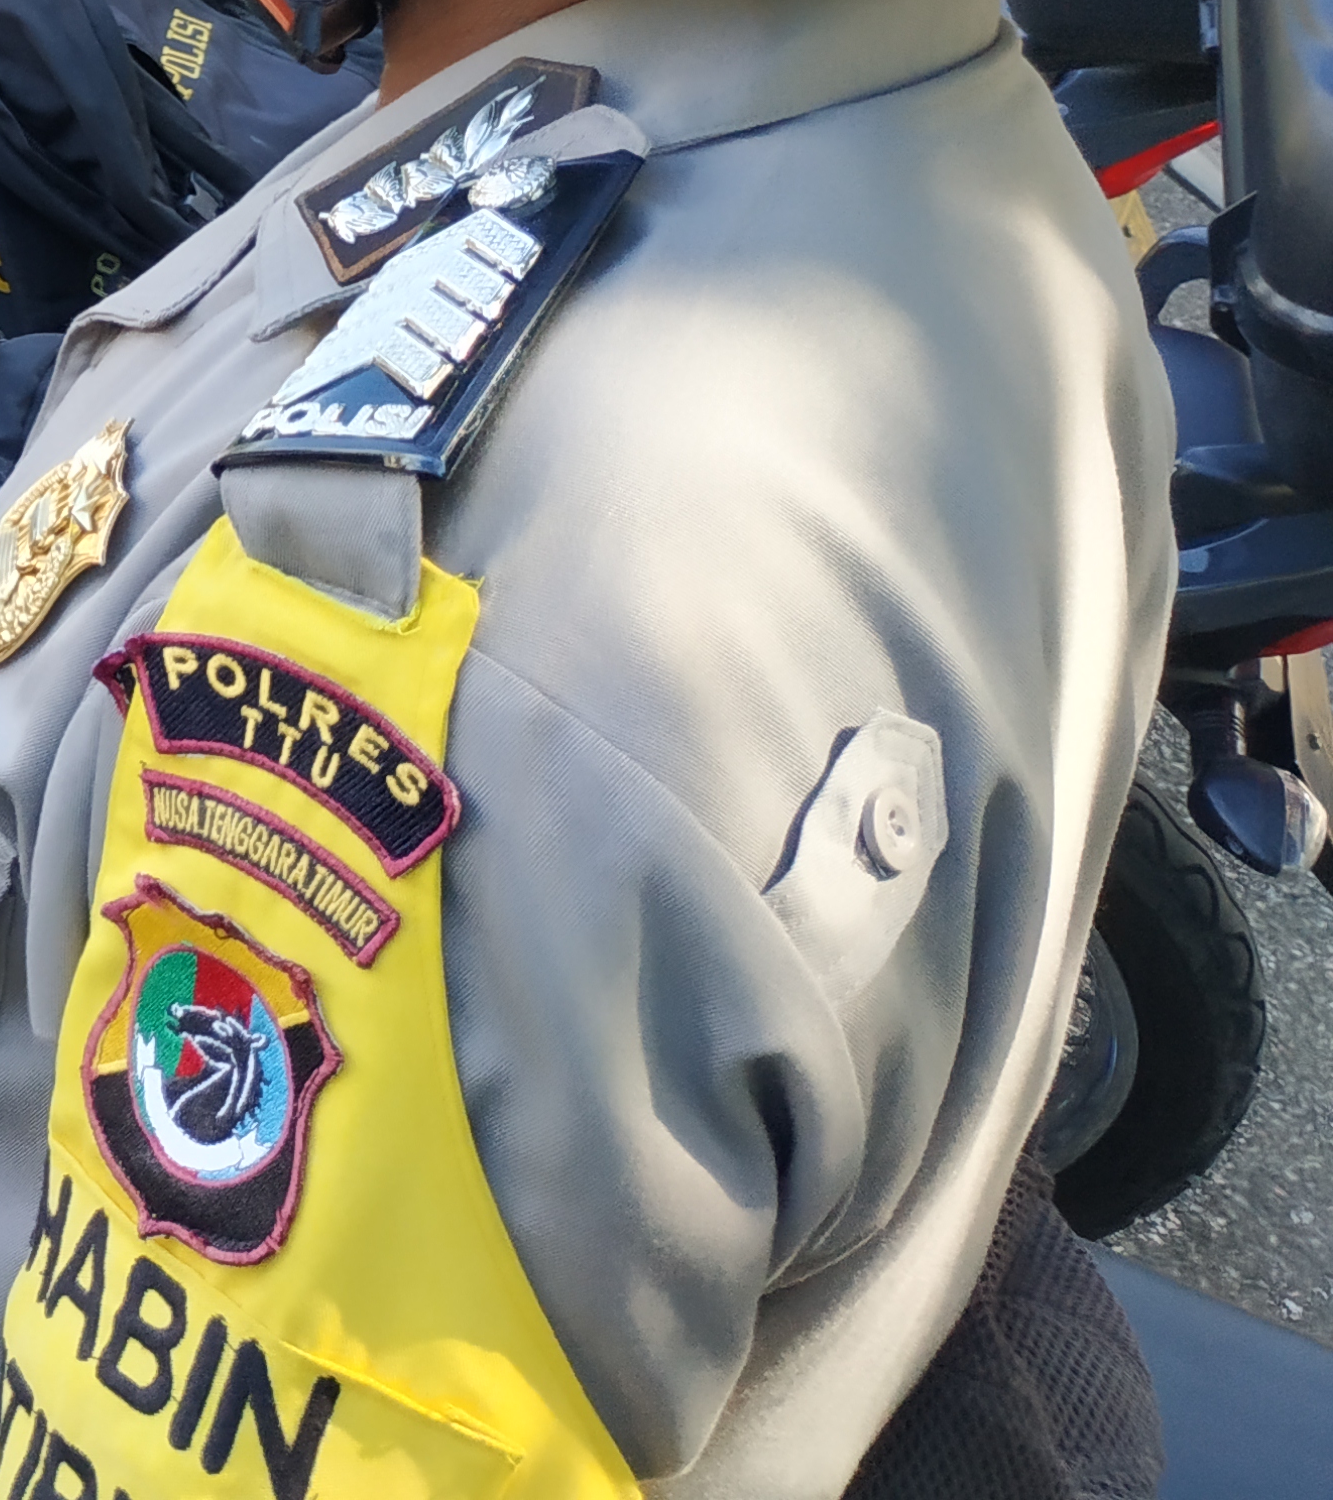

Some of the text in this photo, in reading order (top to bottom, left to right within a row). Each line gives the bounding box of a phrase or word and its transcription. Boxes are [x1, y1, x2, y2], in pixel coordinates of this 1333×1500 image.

[241, 400, 433, 441] POLISI
[162, 645, 429, 807] POLRES
[239, 704, 341, 789] TTU
